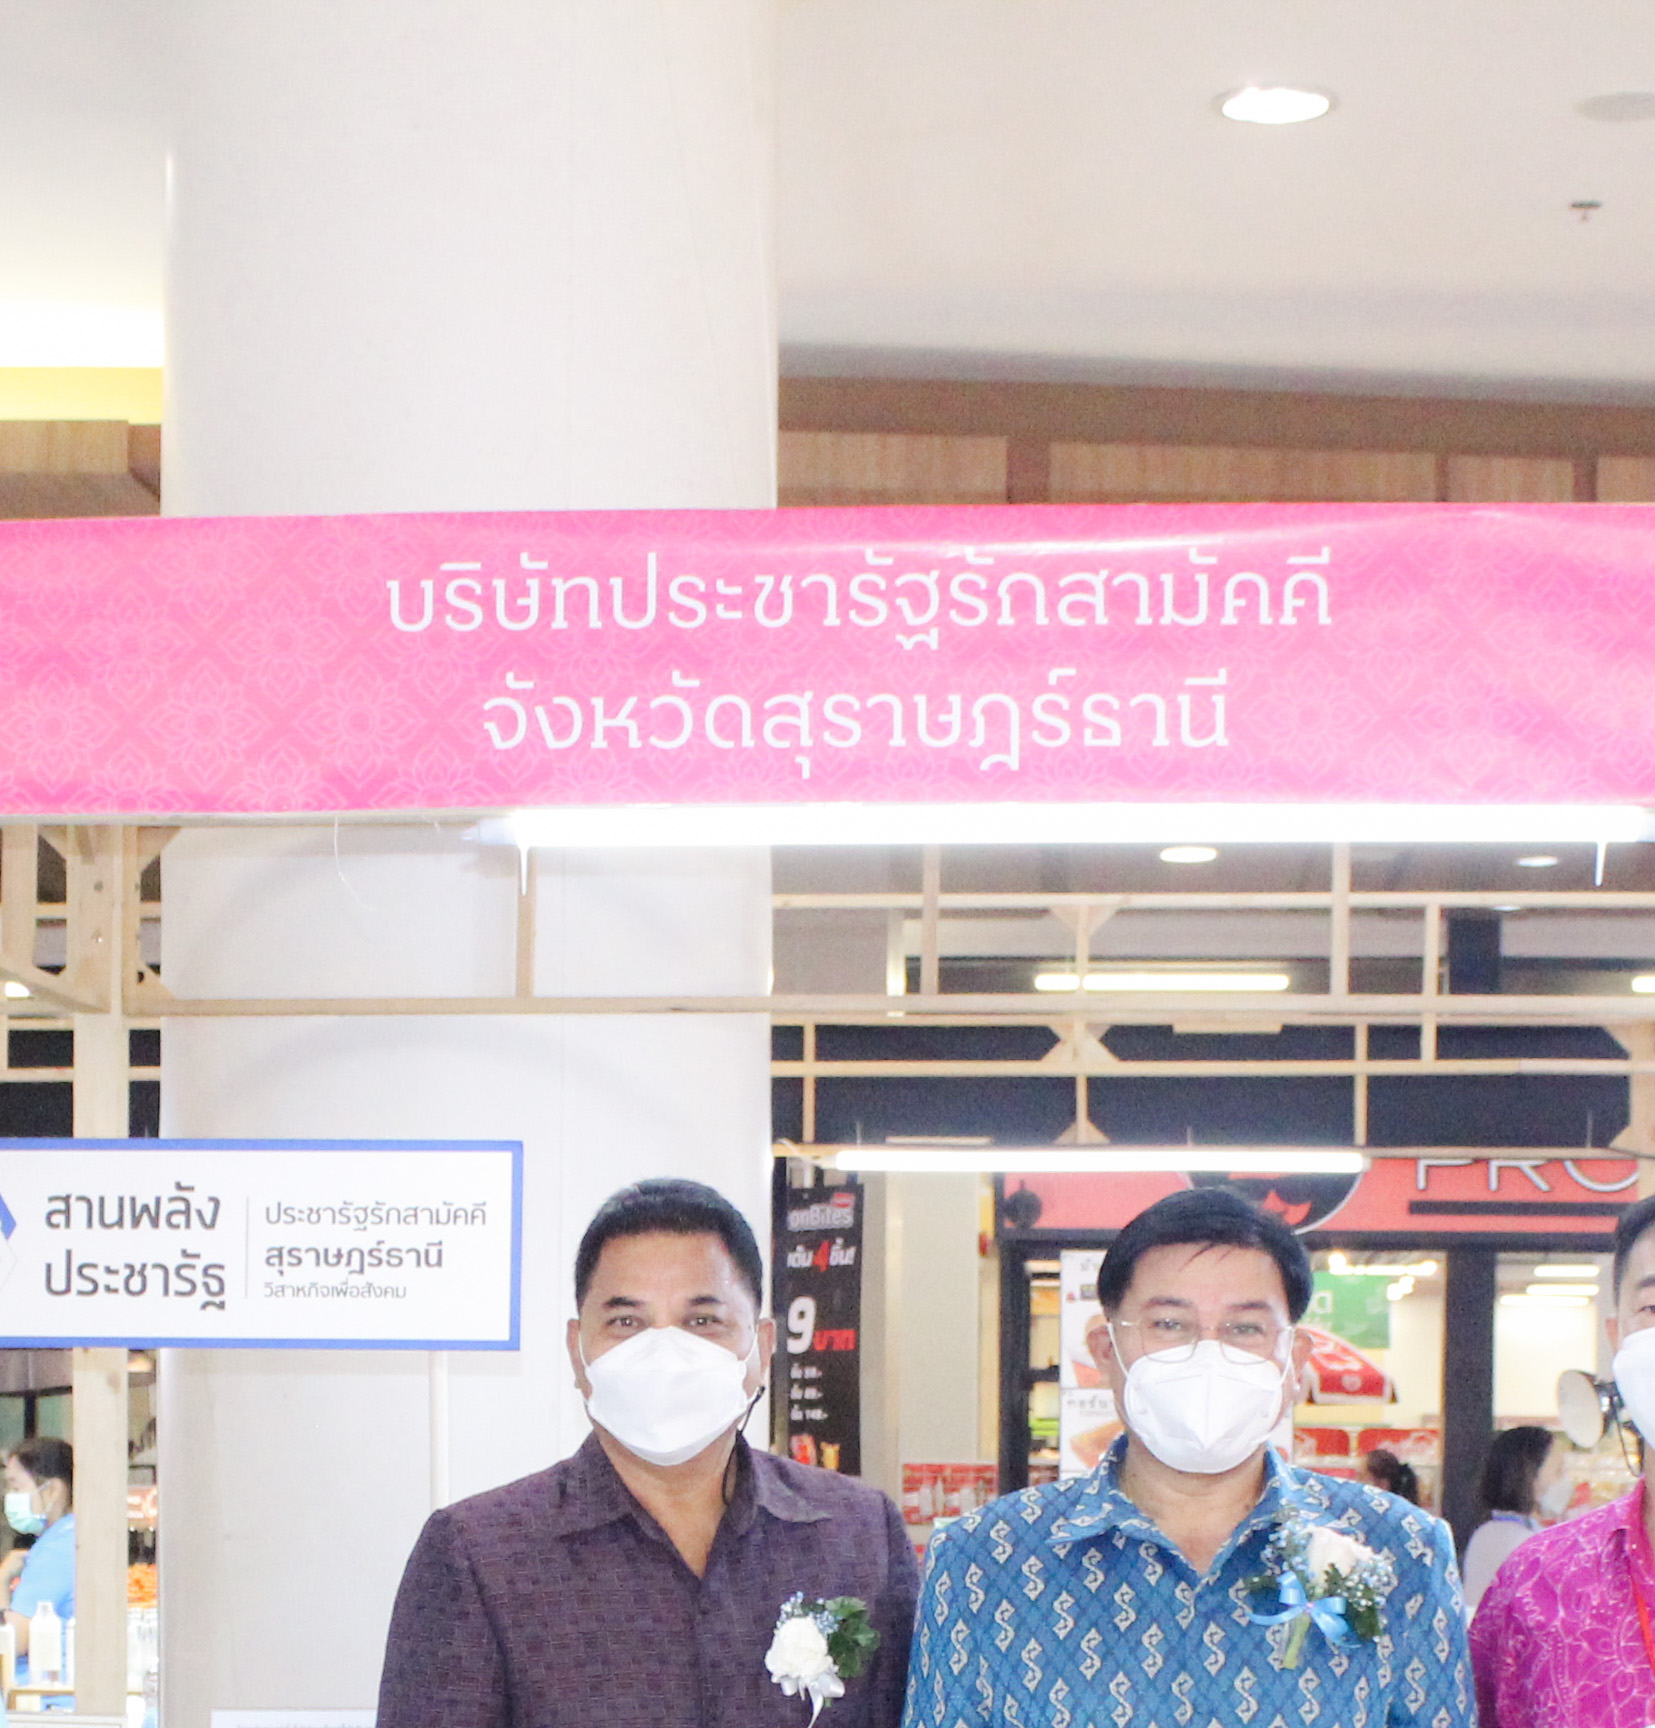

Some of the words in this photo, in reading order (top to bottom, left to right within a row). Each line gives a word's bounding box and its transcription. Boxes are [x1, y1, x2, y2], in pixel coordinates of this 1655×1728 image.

[385, 546, 1333, 650] บริษัทประชารัฐรักสามัคคี
[481, 667, 1230, 779] จังหวัดสุราษฎร์ธานี
[44, 1181, 222, 1231] สานพลัง
[264, 1200, 487, 1232] ประชารัฐรักสามัคคี
[44, 1248, 228, 1311] ประชารัฐ
[264, 1240, 444, 1277] สุราษฎร์ธานี
[263, 1279, 407, 1300] วิสาหกิจเพื่อสังคม
